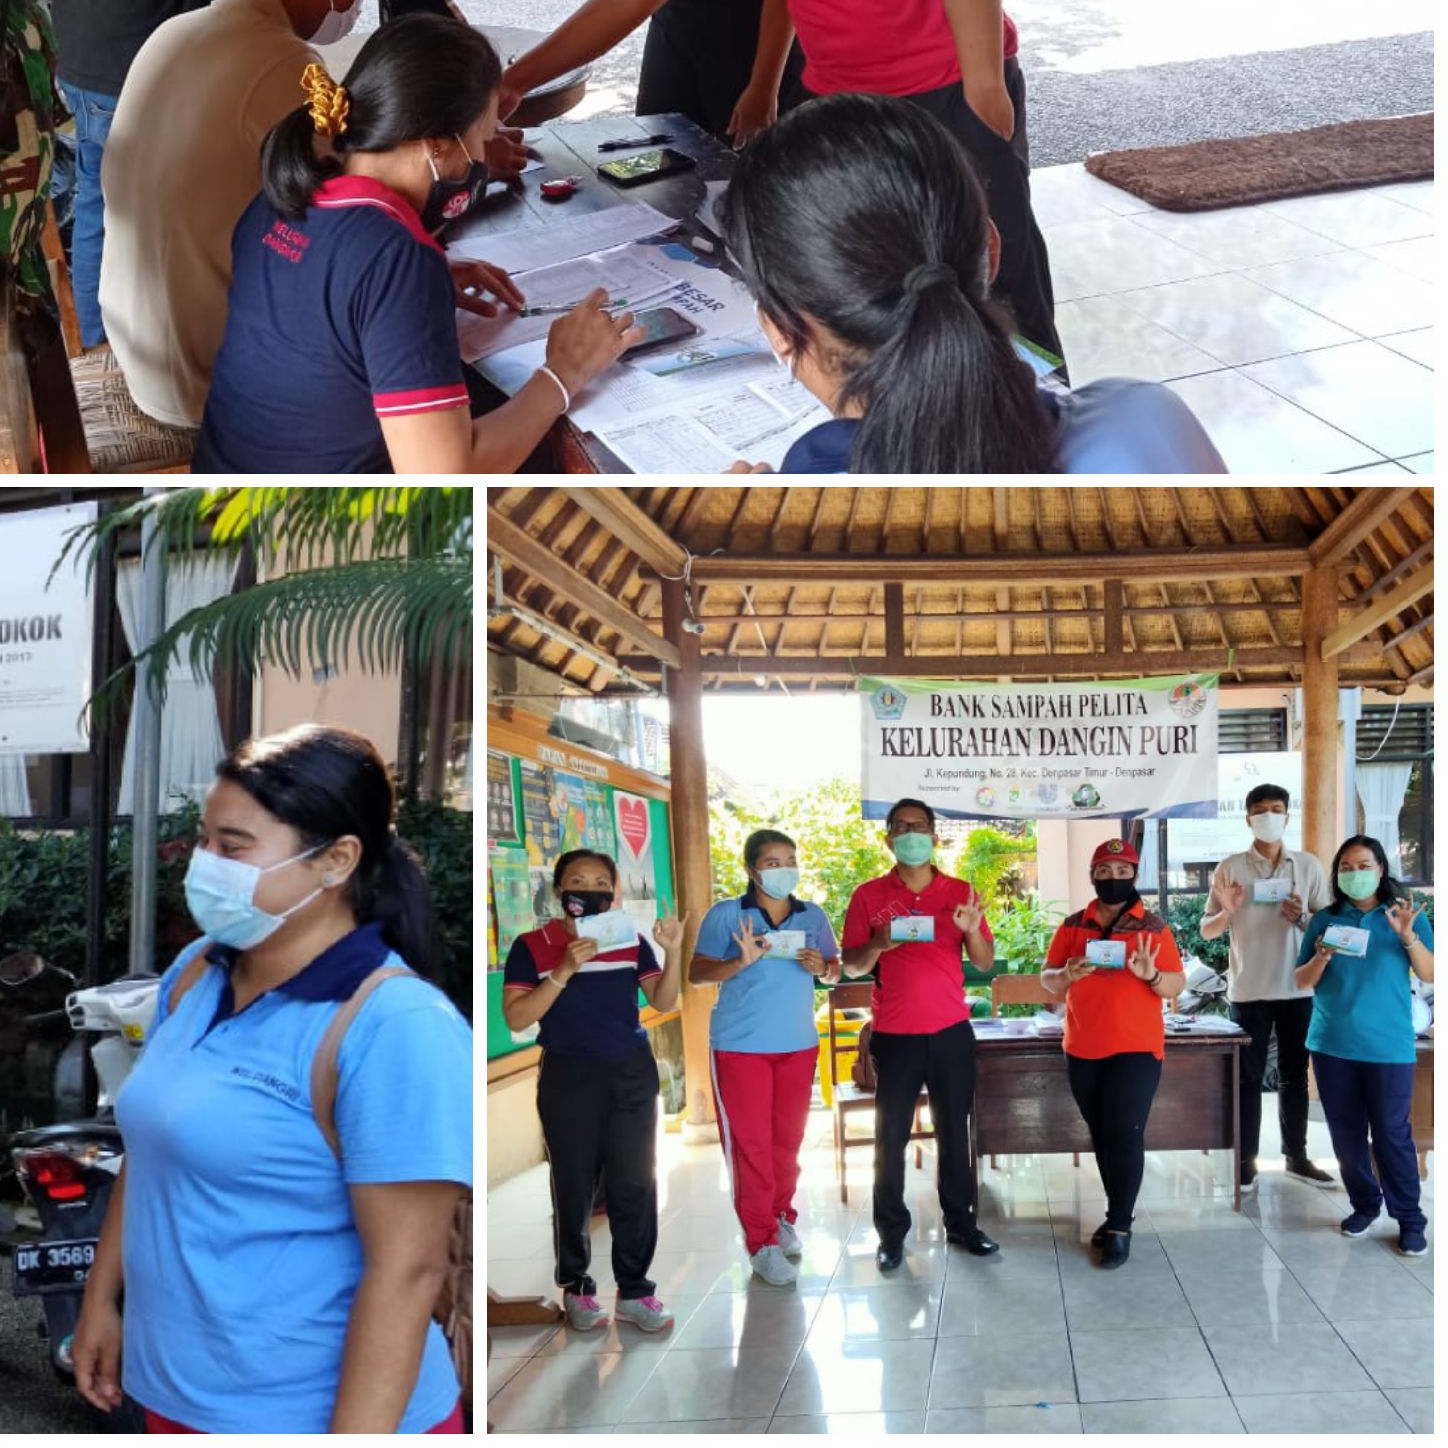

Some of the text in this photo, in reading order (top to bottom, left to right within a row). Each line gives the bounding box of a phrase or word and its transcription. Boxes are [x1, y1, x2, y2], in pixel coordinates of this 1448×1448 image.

[673, 282, 726, 311] BESAR
[929, 692, 1149, 719] BANK SAMPAH PELITA
[880, 724, 1199, 759] KELURAHAN DANGIN PURI
[1041, 767, 1081, 780] Denpasar
[1084, 766, 1108, 778] Timur
[1115, 766, 1156, 779] Denpasar
[18, 1251, 40, 1270] DK
